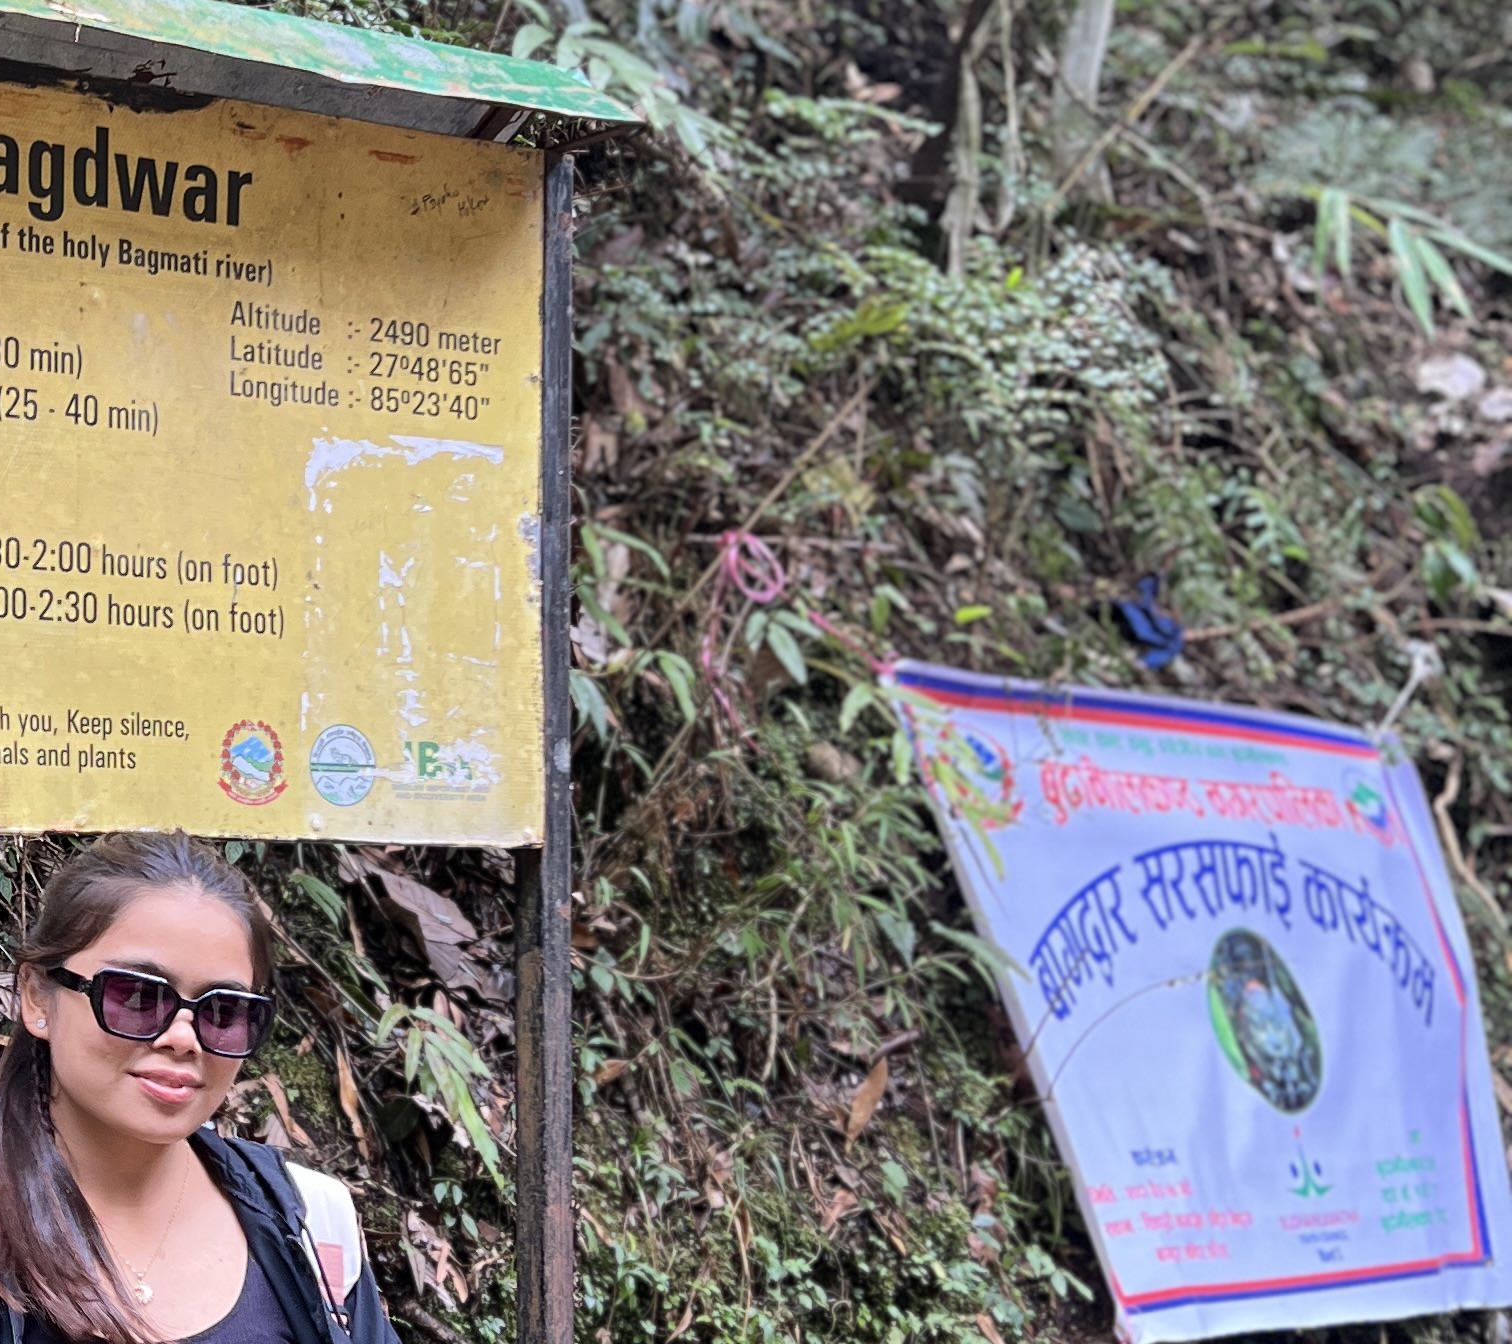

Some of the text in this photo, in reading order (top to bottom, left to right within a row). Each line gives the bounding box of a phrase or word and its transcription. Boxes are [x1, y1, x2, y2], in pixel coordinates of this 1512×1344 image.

[18, 226, 54, 254] the
[63, 231, 110, 267] holy
[119, 239, 207, 275] Bagmati
[216, 254, 272, 286] river)
[231, 299, 322, 335] Altitude
[371, 318, 429, 347] 2490
[439, 332, 501, 354] meter
[31, 342, 81, 379] min)
[231, 334, 322, 369] Latitude
[231, 368, 338, 406] Longitude
[65, 394, 97, 426] 40
[109, 400, 157, 436] min)
[102, 544, 166, 579] hours
[178, 551, 211, 584] (on
[222, 554, 277, 591] foot)
[109, 594, 173, 628] hours
[185, 600, 218, 633] (on
[229, 603, 283, 638] foot)
[18, 714, 57, 736] you,
[68, 709, 112, 740] Keep
[121, 712, 189, 740] silence,
[37, 743, 69, 766] and
[79, 744, 135, 773] plants
